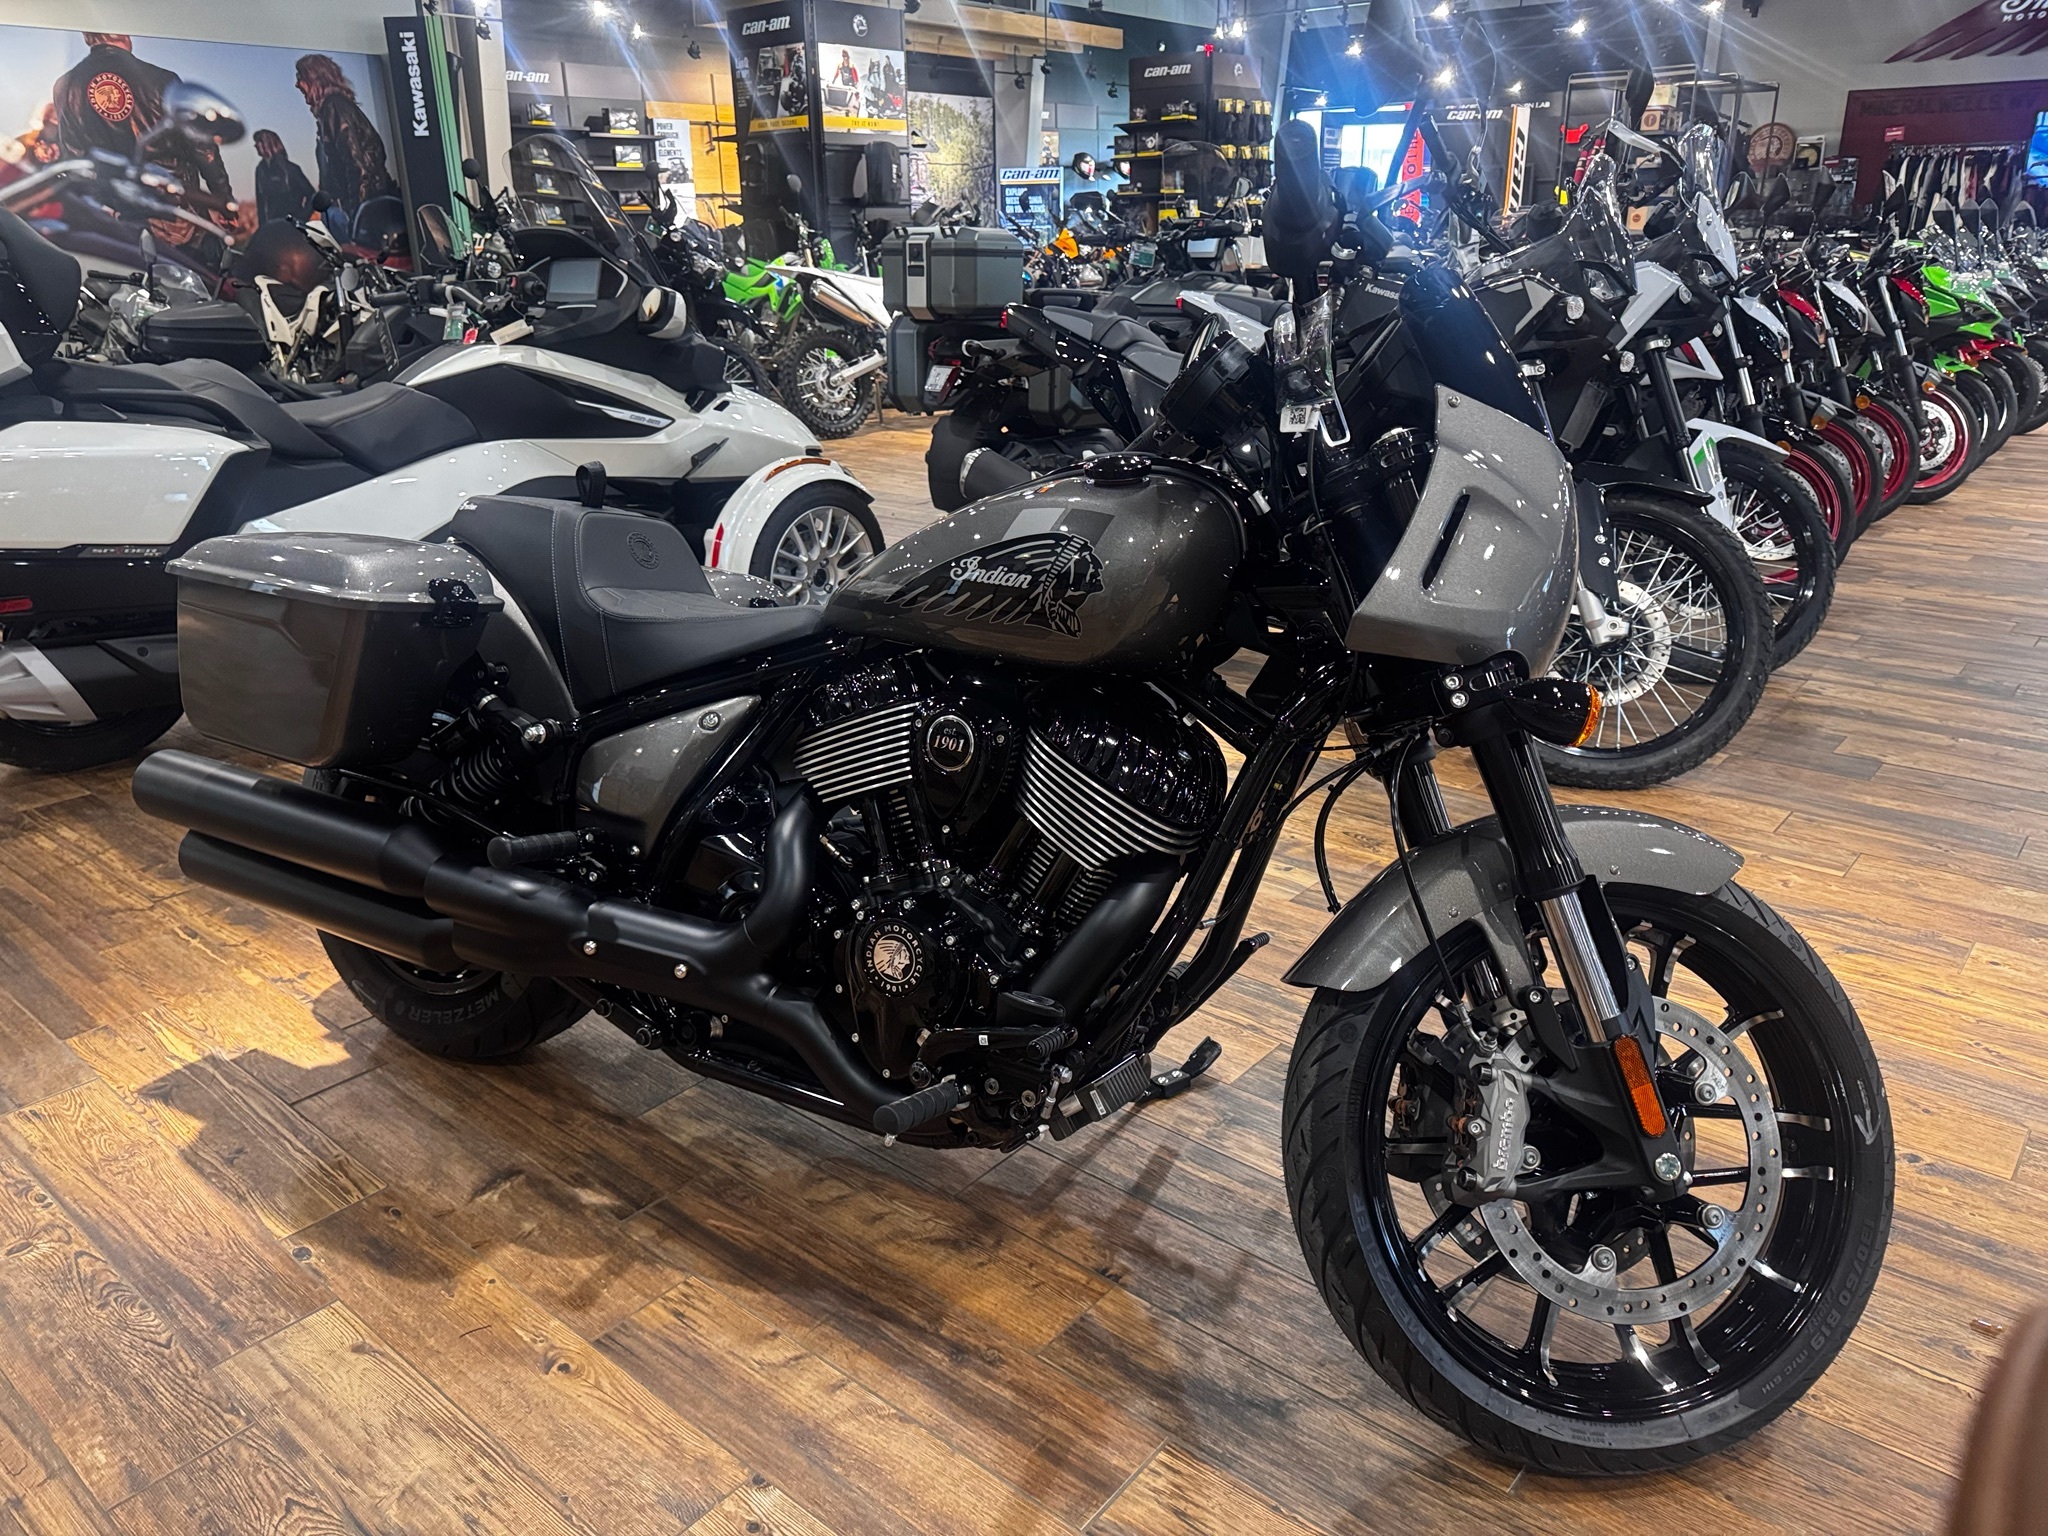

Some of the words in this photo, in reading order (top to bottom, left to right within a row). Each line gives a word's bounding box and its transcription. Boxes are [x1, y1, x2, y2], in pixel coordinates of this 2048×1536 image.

[742, 16, 790, 36] can-am
[505, 70, 551, 83] an-am
[1144, 63, 1192, 78] can-am
[399, 31, 430, 137] Kawasaki
[1002, 169, 1060, 180] can-am
[1364, 282, 1402, 300] Kawasa
[629, 414, 661, 426] can-am
[949, 556, 1032, 589] Indian
[933, 735, 965, 752] 1901
[866, 929, 881, 973] INDIAN
[884, 924, 924, 985] MOTORCYCLE
[880, 981, 902, 992] 1901
[408, 987, 500, 1024] METZELER
[1492, 1097, 1515, 1171] brembo
